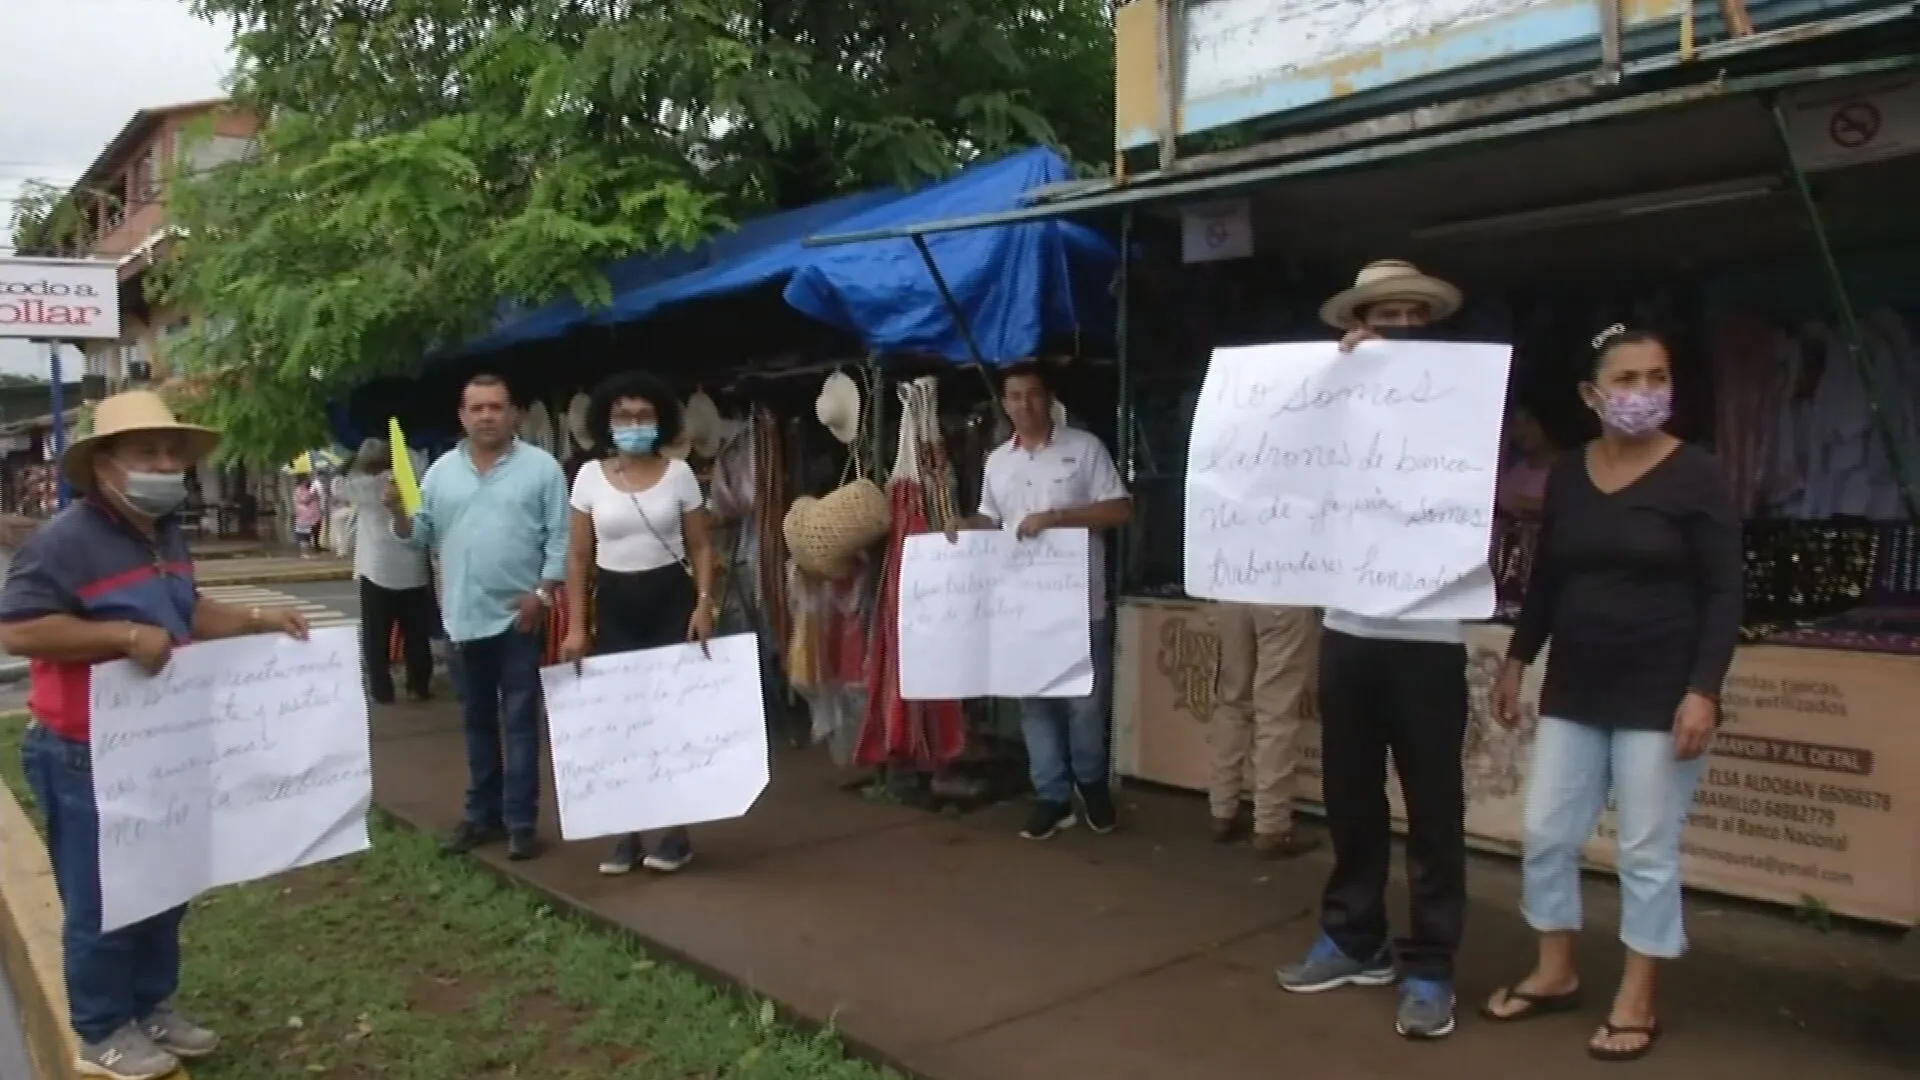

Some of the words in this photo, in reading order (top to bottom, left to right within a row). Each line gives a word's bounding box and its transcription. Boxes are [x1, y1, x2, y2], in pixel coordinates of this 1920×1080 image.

[74, 283, 99, 297] a
[0, 299, 102, 326] ollar
[1359, 430, 1383, 472] de
[1257, 495, 1290, 526] de
[1769, 741, 1783, 760] Y
[1784, 742, 1806, 764] AL
[1808, 747, 1861, 770] DETAL
[1707, 766, 1740, 787] ELSA
[1719, 814, 1736, 833] al
[1737, 817, 1780, 841] Banco
[1783, 824, 1849, 852] Nacional
